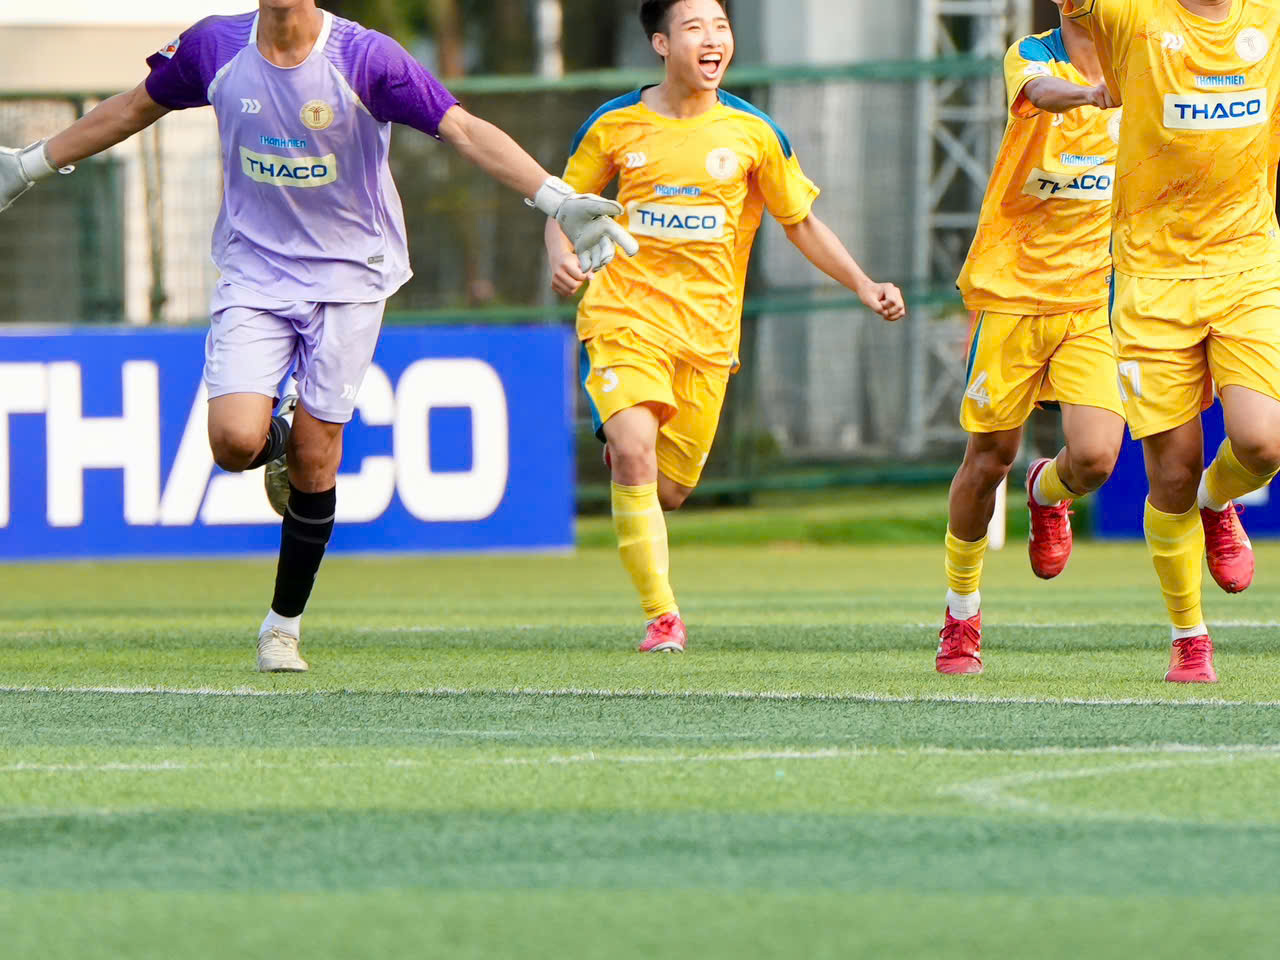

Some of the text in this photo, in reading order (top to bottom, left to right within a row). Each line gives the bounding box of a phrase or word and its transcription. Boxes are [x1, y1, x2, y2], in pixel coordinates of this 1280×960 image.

[1174, 99, 1261, 120] THACO
[246, 157, 327, 180] THACO
[636, 209, 717, 230] THACO
[967, 371, 990, 408] 4
